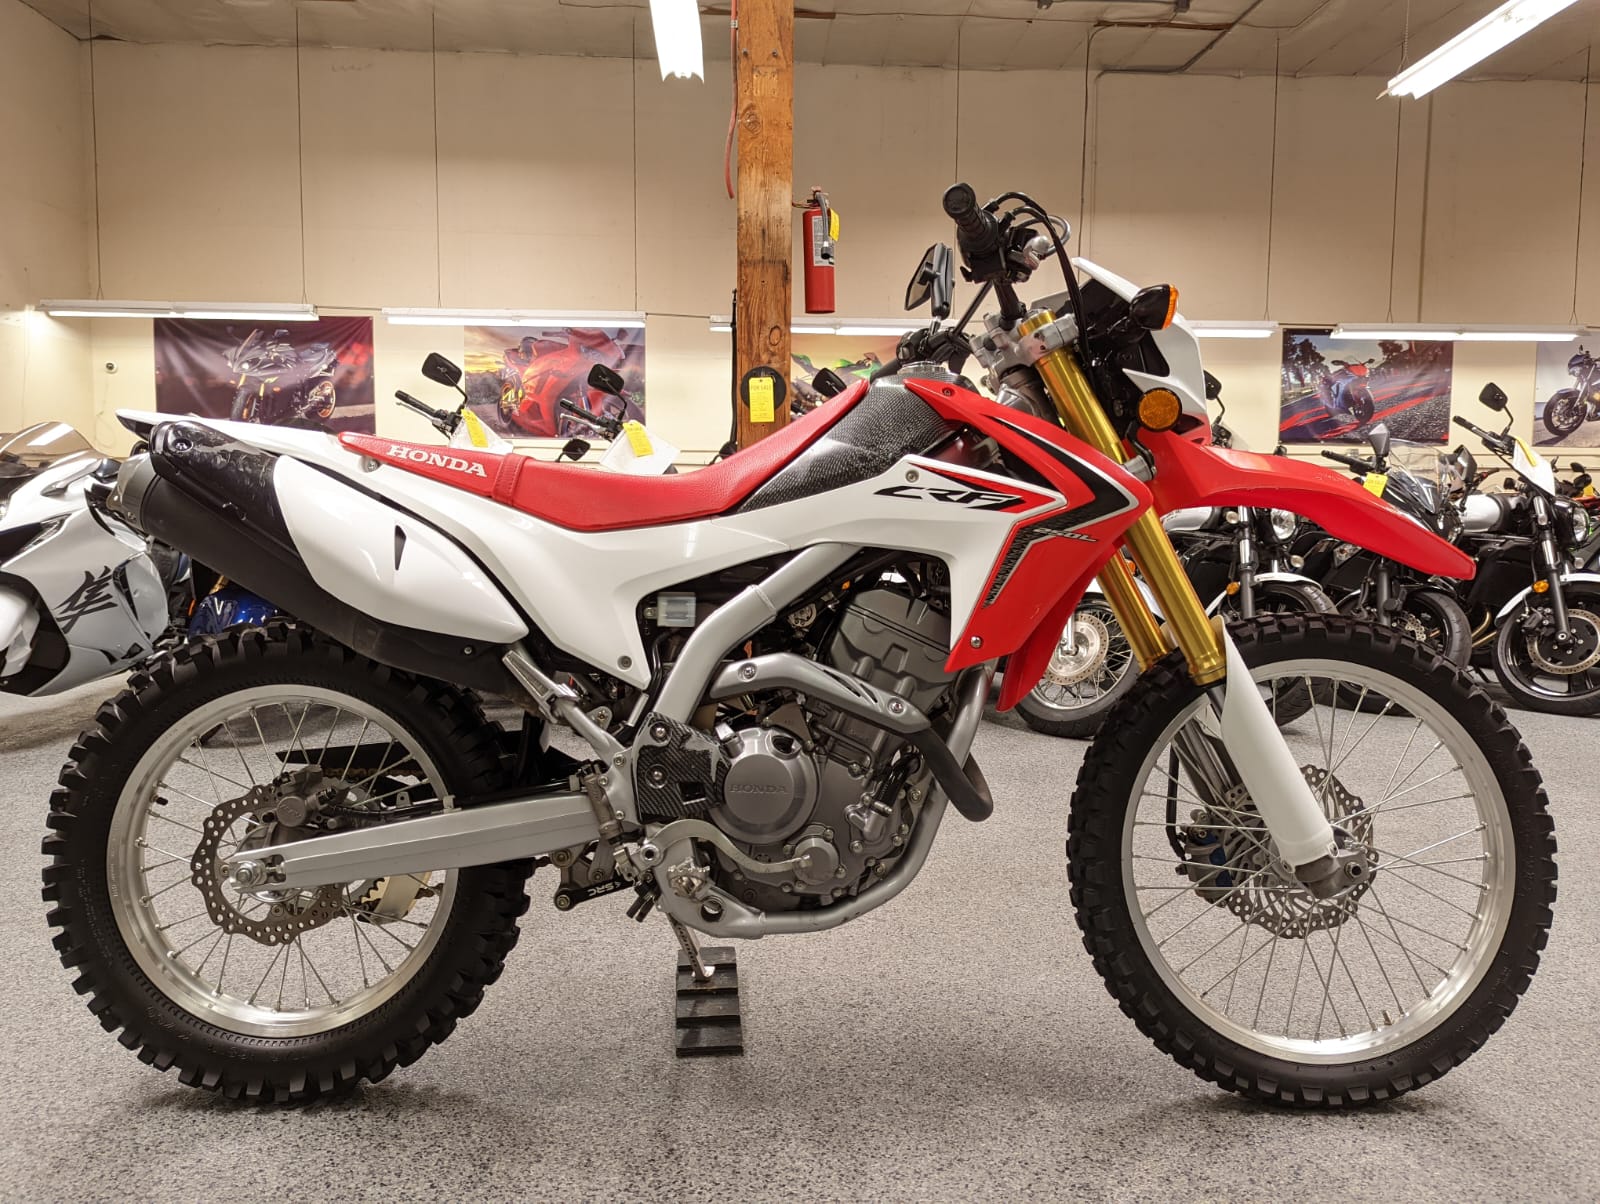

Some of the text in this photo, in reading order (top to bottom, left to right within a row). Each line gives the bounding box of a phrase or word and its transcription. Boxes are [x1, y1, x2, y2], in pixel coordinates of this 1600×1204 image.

[386, 445, 488, 478] HONDA
[873, 485, 1027, 512] CRF
[729, 784, 788, 793] HONDA
[587, 882, 615, 897] SRC
